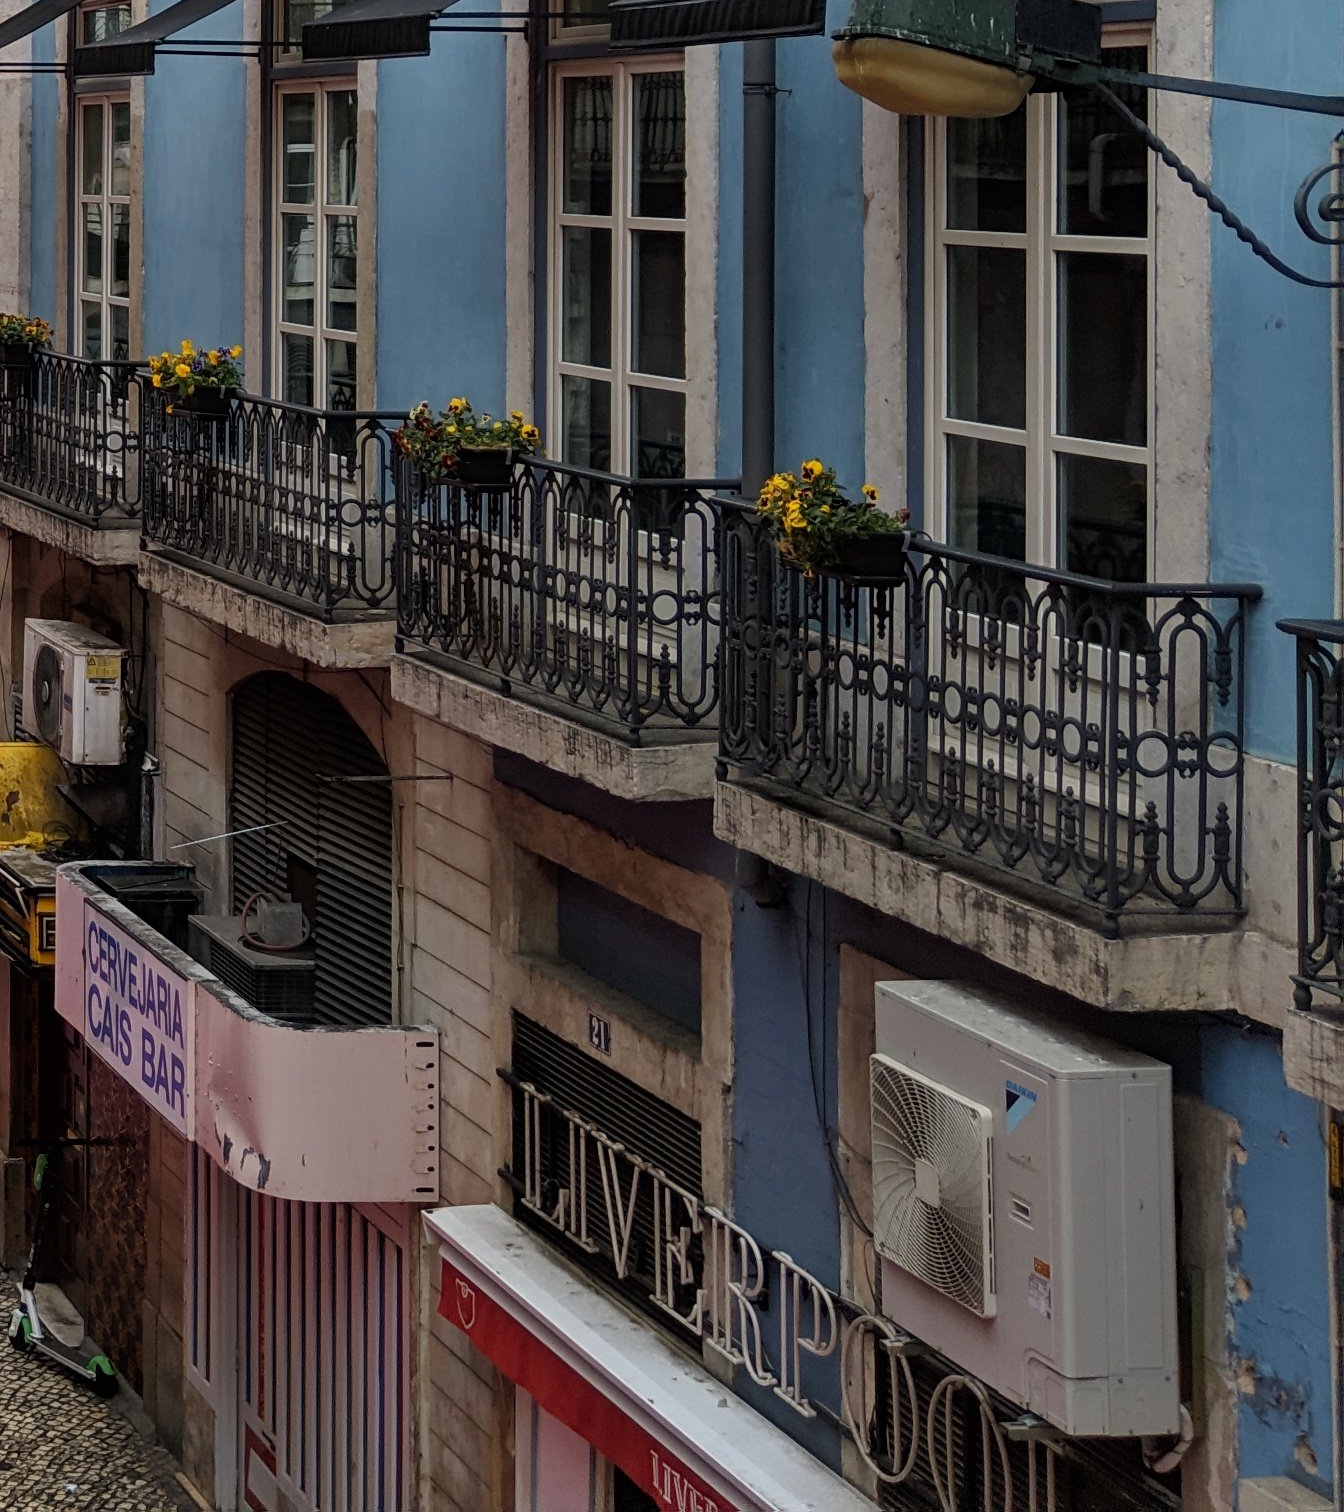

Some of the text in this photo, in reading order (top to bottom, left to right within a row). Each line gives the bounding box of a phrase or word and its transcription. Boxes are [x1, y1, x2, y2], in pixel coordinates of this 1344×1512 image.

[88, 920, 185, 1051] CERVEJARIA
[88, 983, 186, 1120] CAIS BAR
[591, 1015, 606, 1050] 21
[1005, 1079, 1038, 1103] DAIKIN
